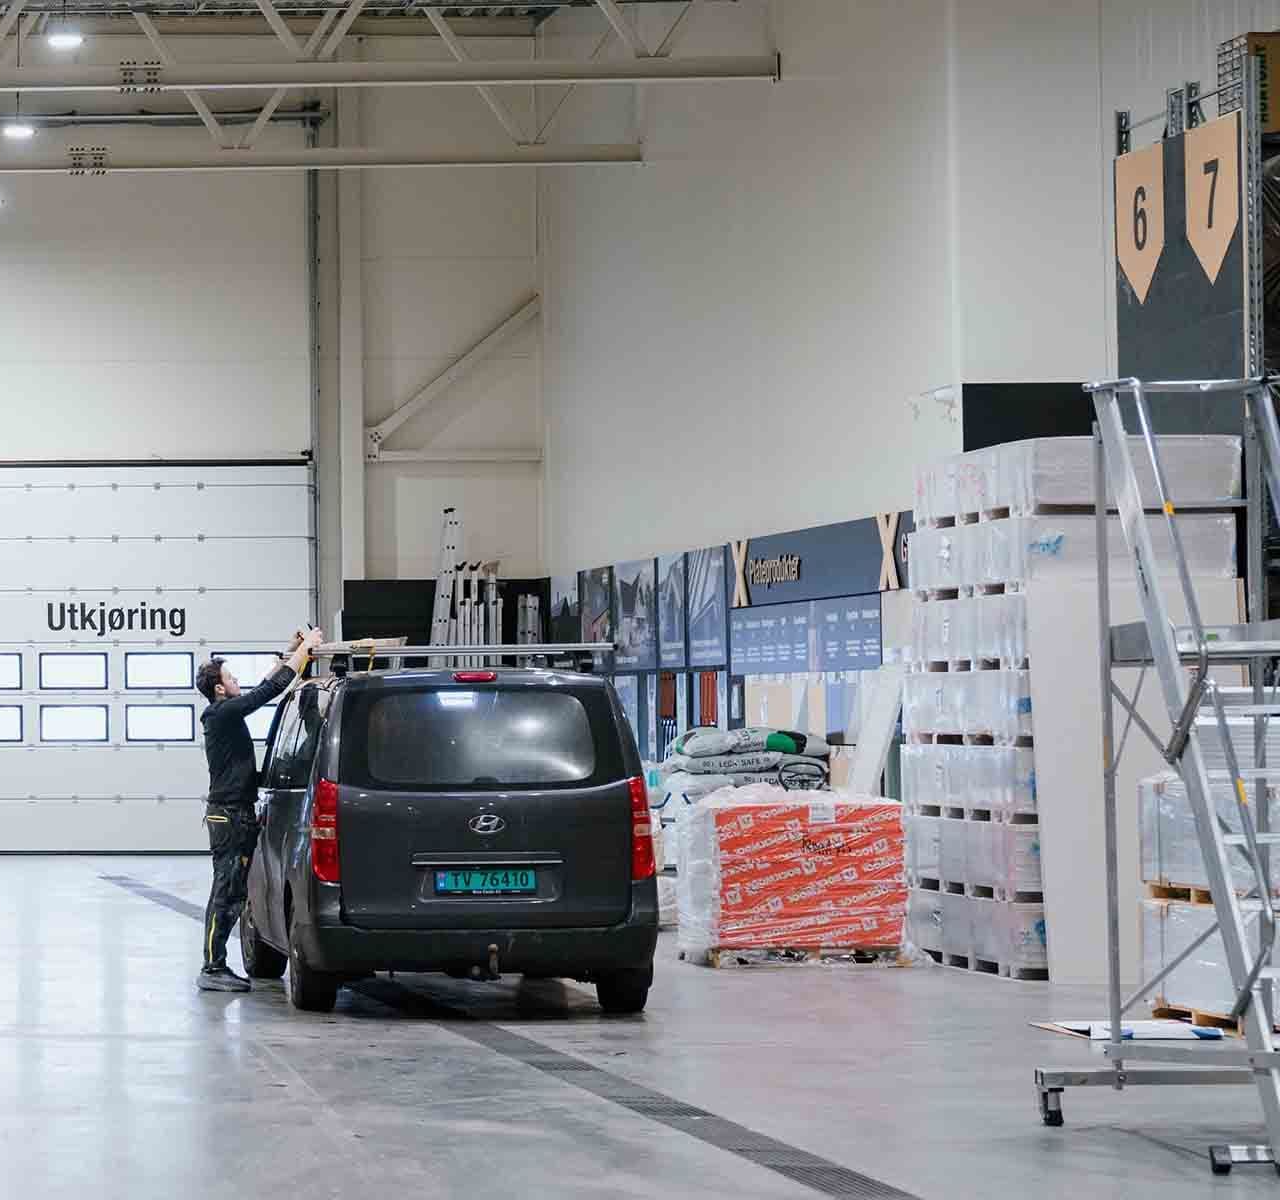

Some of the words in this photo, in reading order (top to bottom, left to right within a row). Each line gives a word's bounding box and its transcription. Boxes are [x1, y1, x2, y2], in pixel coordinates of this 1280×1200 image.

[1133, 186, 1147, 251] 6
[1203, 158, 1219, 229] 7
[47, 601, 186, 637] Utkjøring
[451, 871, 472, 888] TV
[480, 871, 529, 888] 76410
